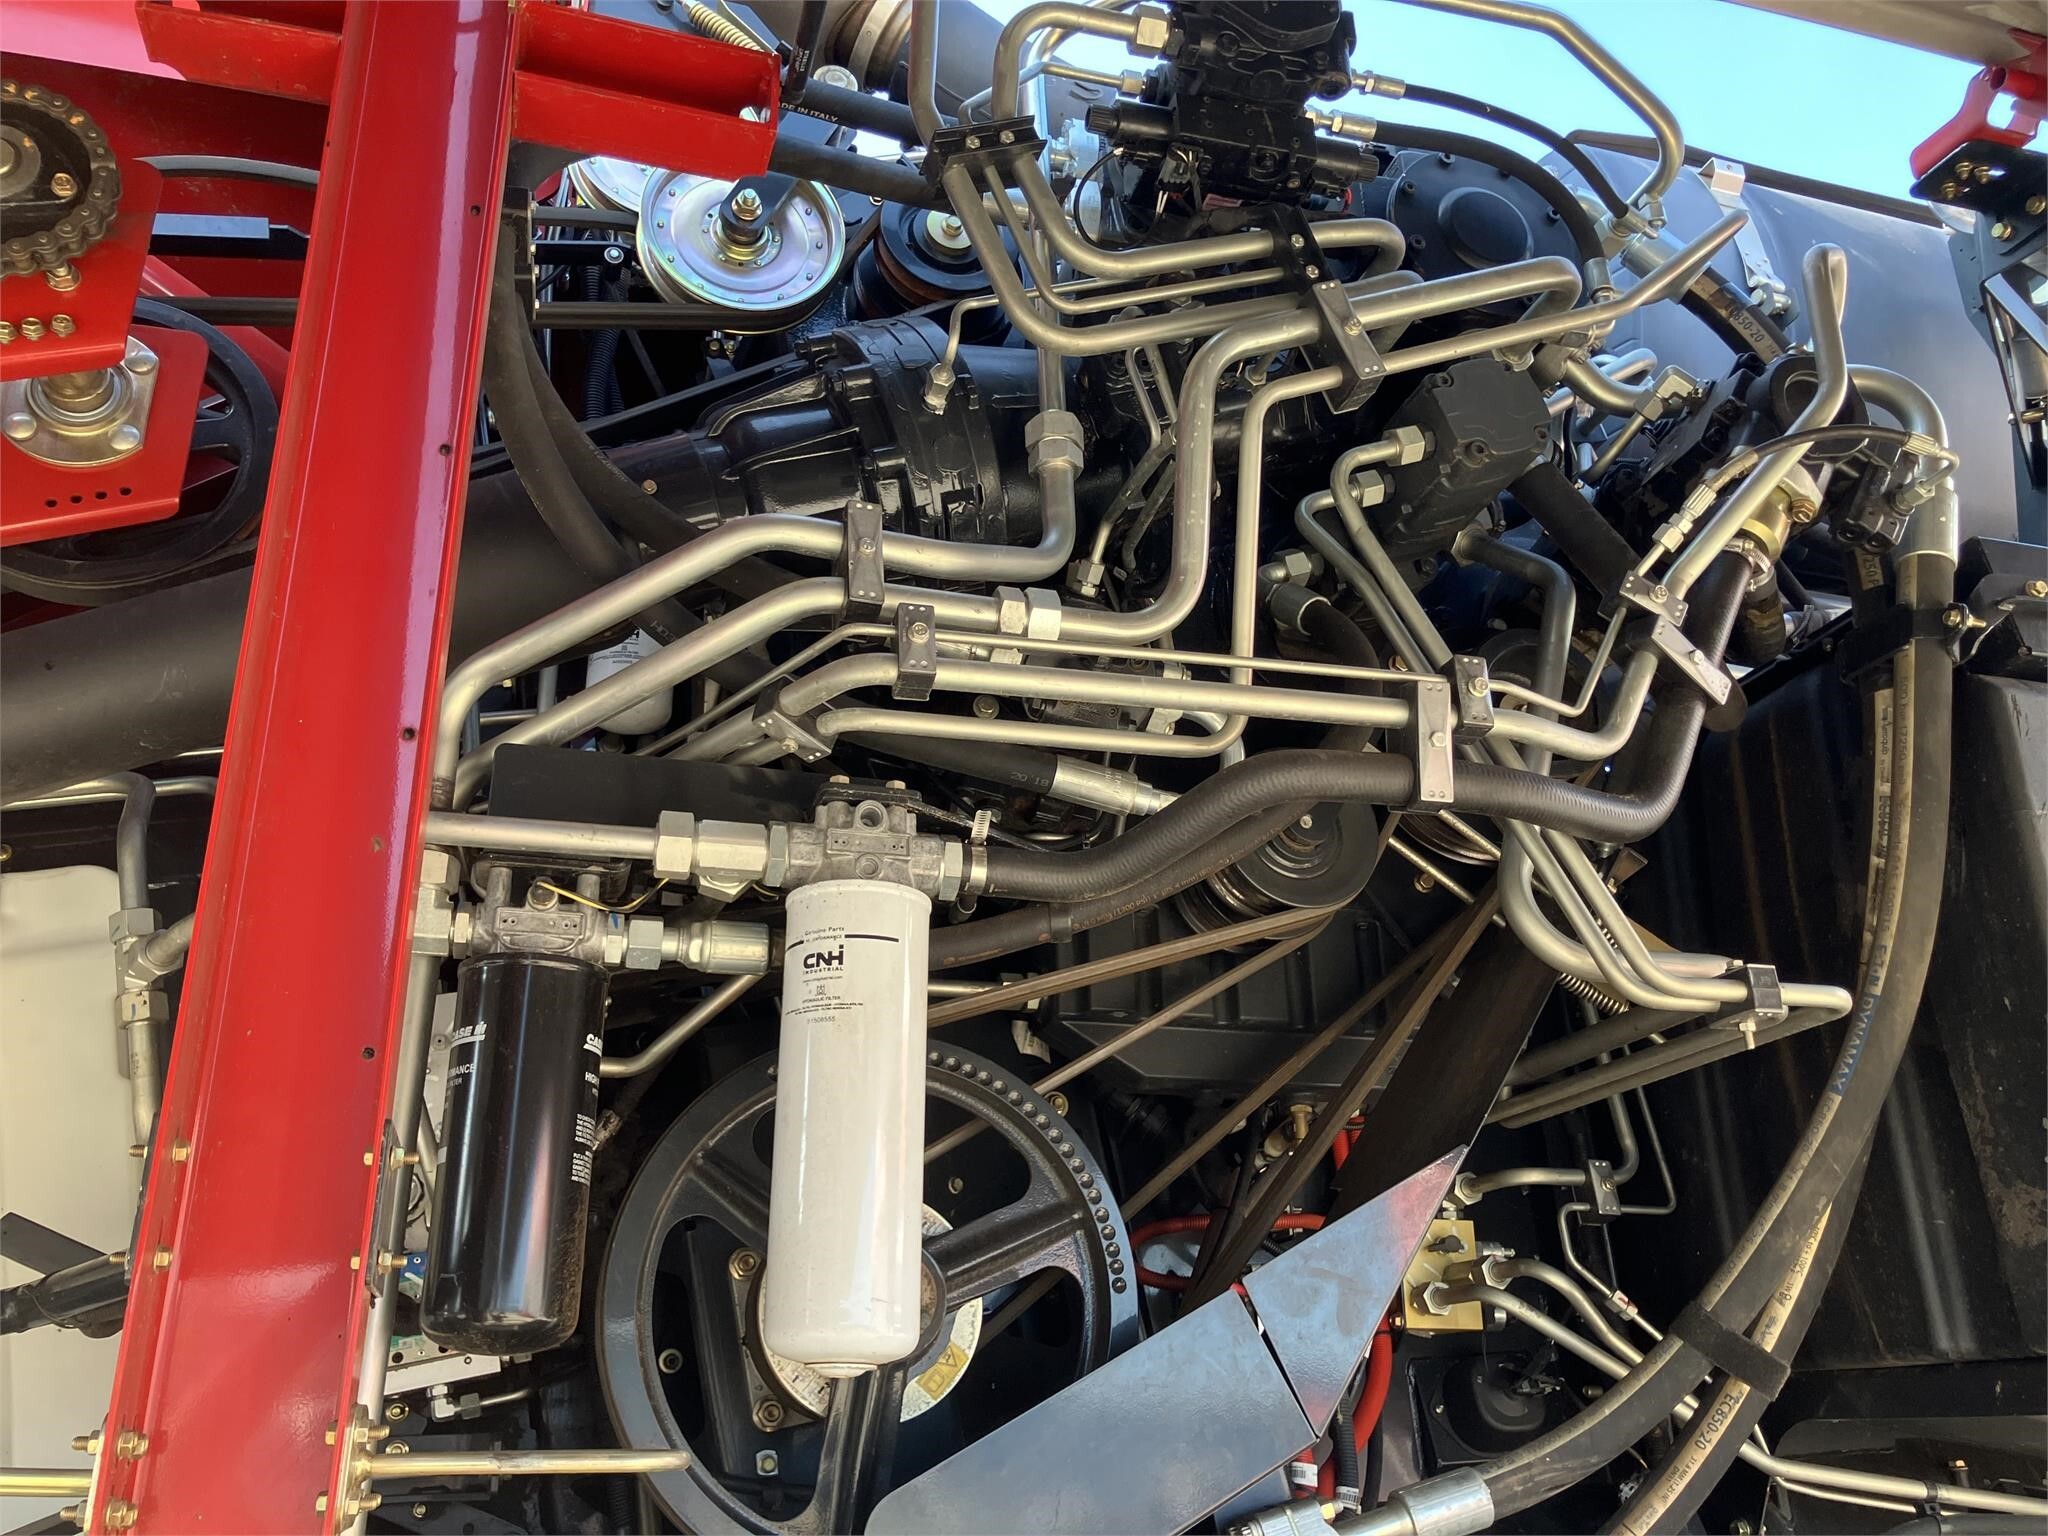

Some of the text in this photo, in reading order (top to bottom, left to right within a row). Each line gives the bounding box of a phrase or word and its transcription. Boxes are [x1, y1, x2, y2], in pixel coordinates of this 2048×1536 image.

[797, 106, 808, 115] IN
[810, 110, 839, 123] ITALY
[802, 967, 844, 975] INDUSTRIAL
[1831, 996, 1876, 1094] DYNAMAX
[1695, 1394, 1735, 1450] EC850-20
